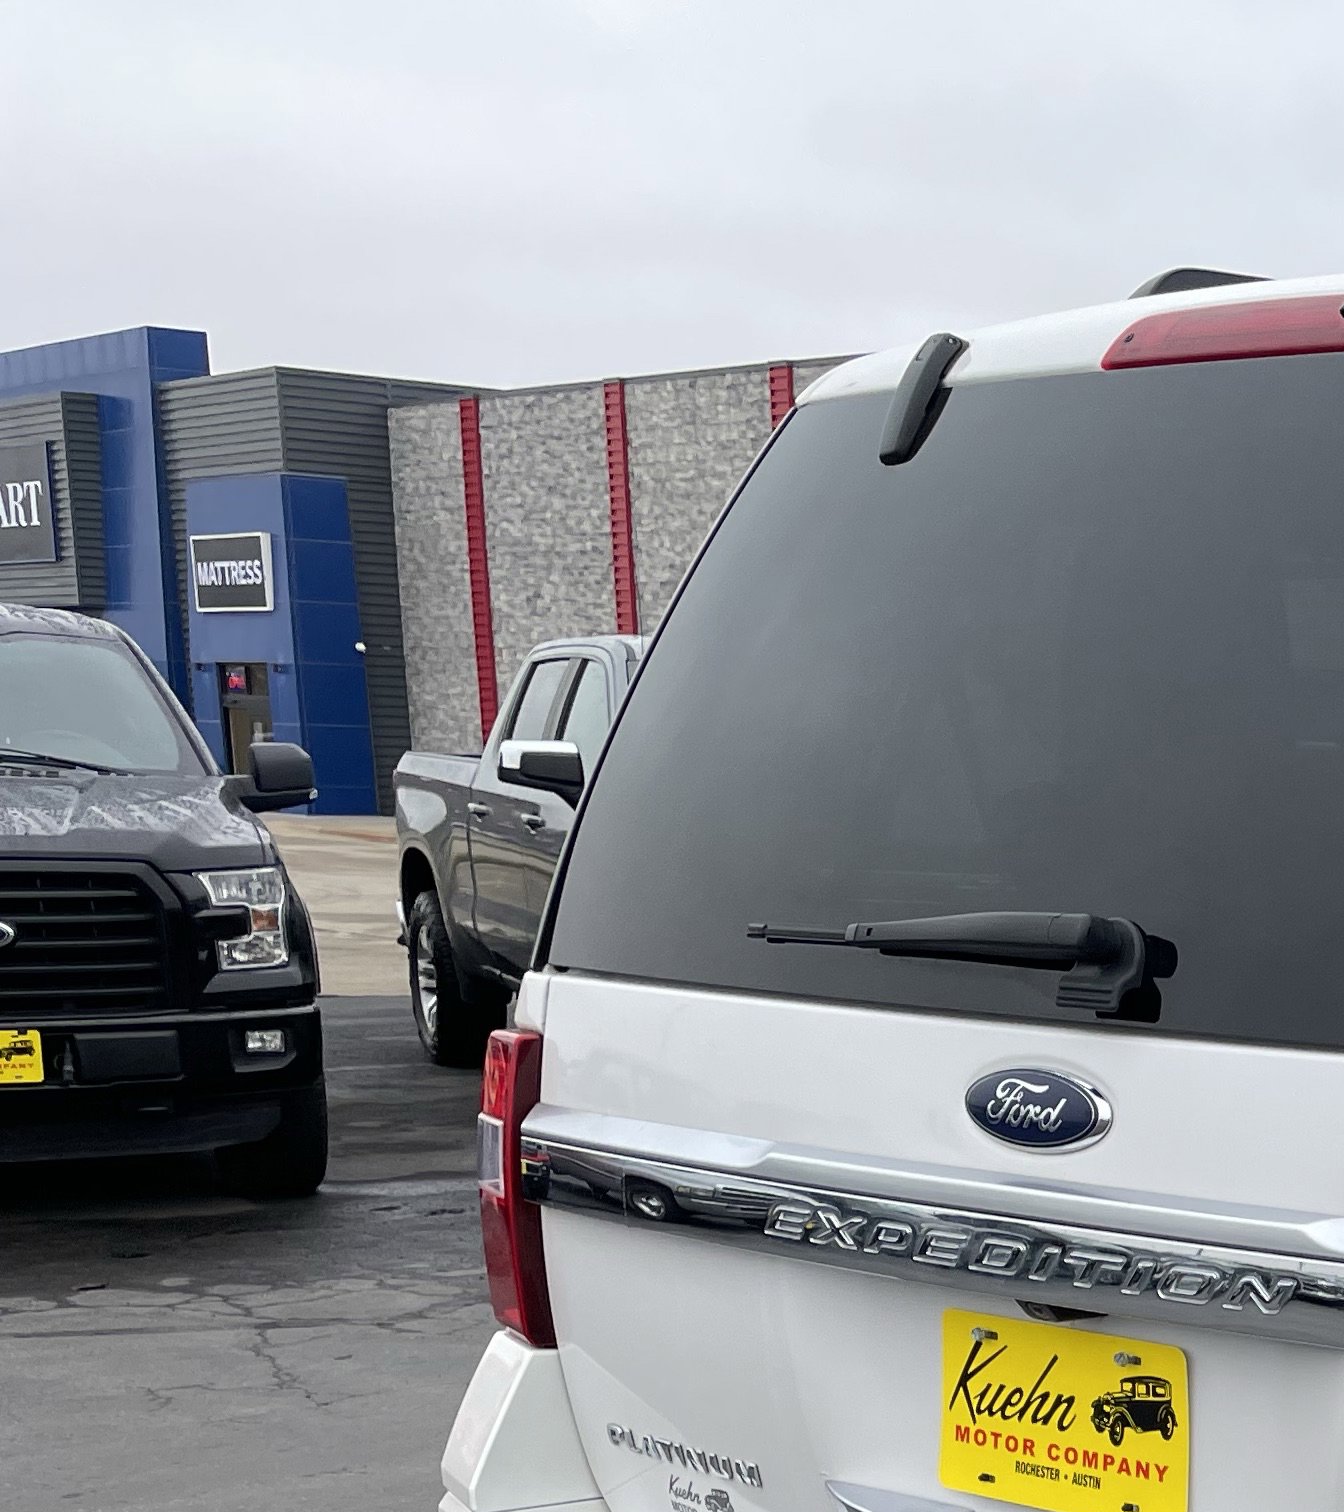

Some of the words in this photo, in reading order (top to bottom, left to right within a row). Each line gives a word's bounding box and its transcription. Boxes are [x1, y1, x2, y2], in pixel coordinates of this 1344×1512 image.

[196, 559, 262, 586] MATTRESS
[986, 1077, 1067, 1134] Ford
[763, 1202, 1297, 1315] EXPEDITION
[949, 1340, 1076, 1432] Kuehn
[606, 1422, 763, 1488] PLATINUM
[955, 1424, 1035, 1457] MOTOR
[1047, 1443, 1169, 1483] COMPANY
[1015, 1460, 1060, 1481] ROCHESTER
[1072, 1472, 1101, 1490] AUSTIN
[669, 1474, 701, 1504] Kuehn
